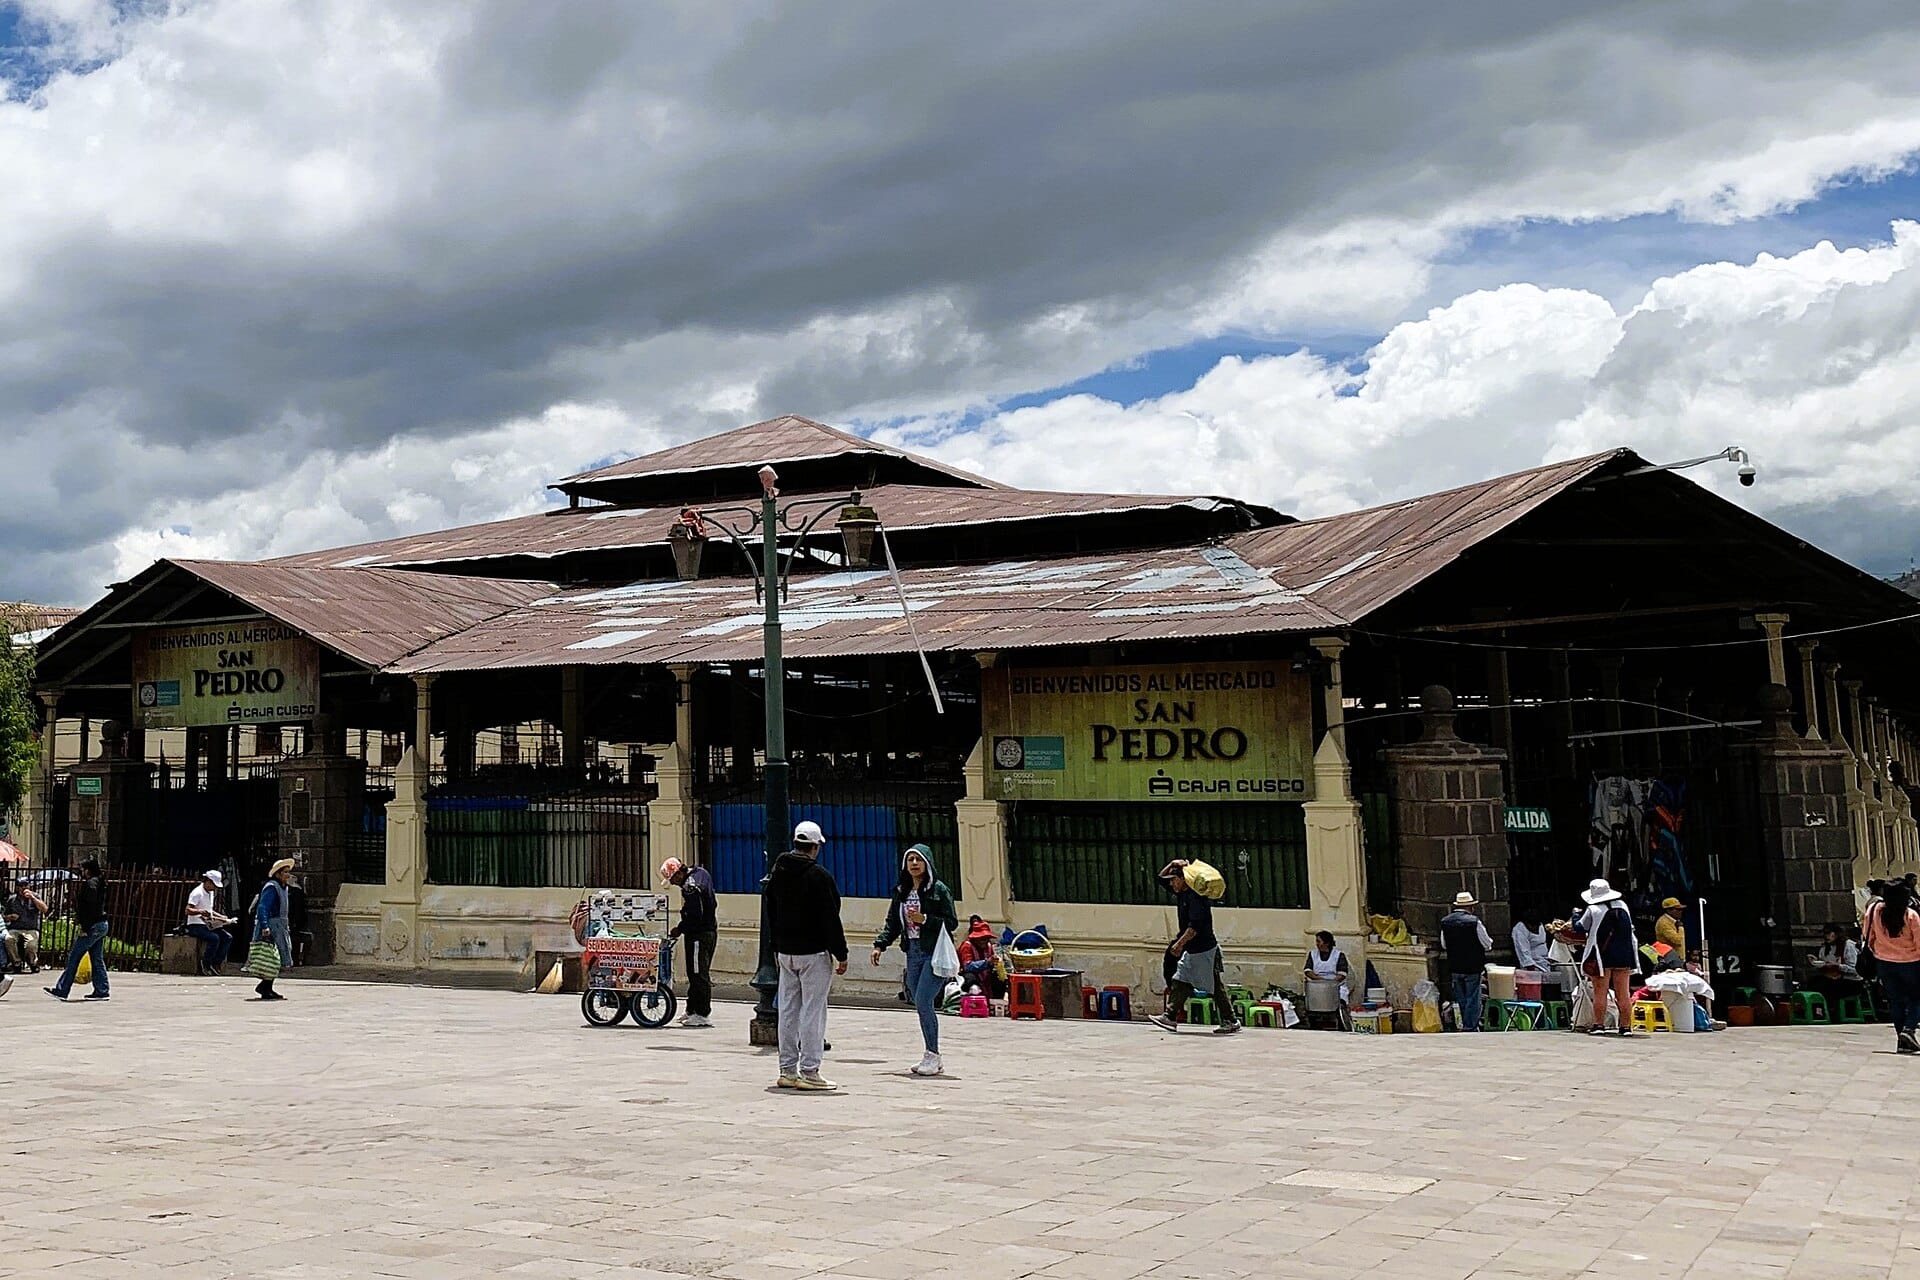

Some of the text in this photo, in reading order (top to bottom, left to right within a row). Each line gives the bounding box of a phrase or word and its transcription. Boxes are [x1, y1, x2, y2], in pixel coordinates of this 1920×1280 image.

[150, 631, 224, 650] BIENVENIDOS
[227, 631, 241, 643] AL
[217, 651, 253, 667] SAN
[194, 669, 284, 697] PEDRO
[1013, 671, 1275, 693] BIENVENIDOS AL MERCADO
[243, 705, 315, 718] CAJA CUSCO
[1134, 698, 1195, 723] SAN
[1090, 725, 1247, 760] PEDRO
[1178, 779, 1304, 793] CAJA CUSCO
[588, 940, 596, 951] SE
[1716, 955, 1741, 974] 12
